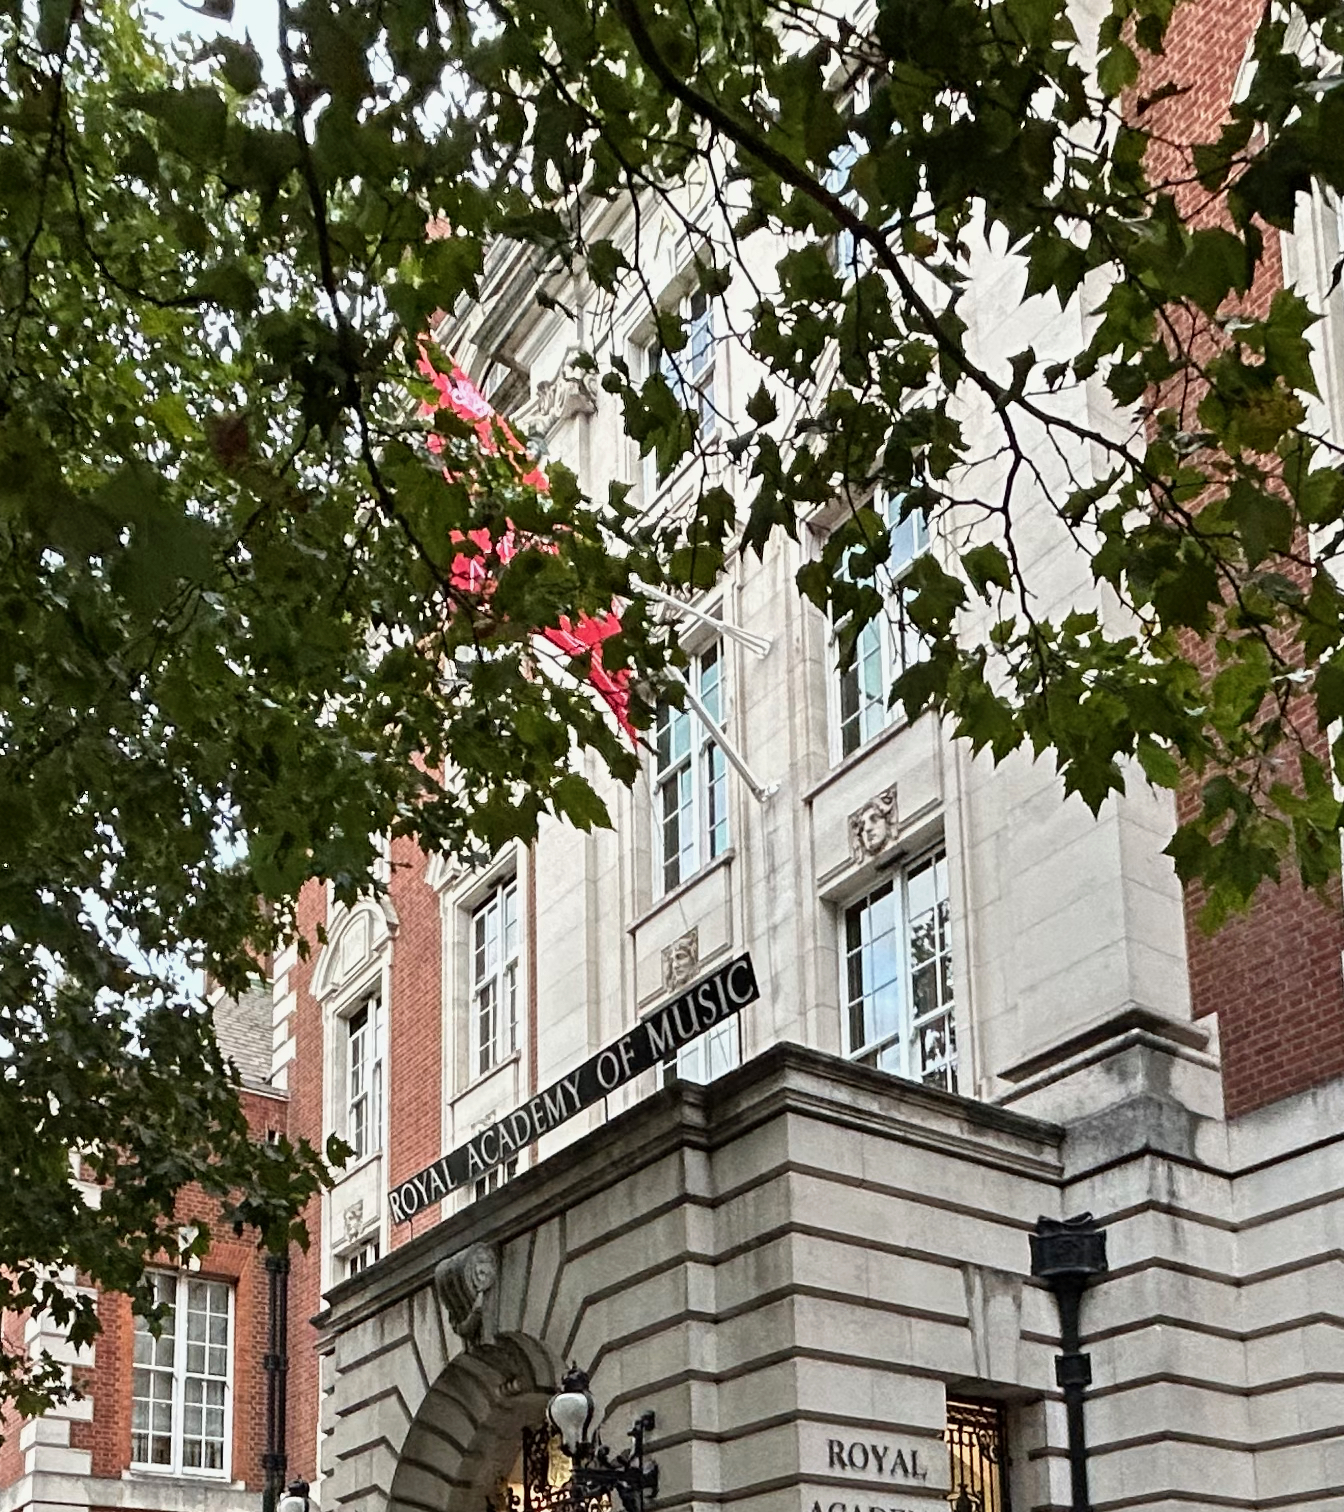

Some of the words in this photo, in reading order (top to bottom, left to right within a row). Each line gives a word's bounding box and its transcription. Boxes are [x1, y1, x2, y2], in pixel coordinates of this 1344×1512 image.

[389, 1160, 457, 1223] ROYAL
[467, 1071, 582, 1177] ACADEMY
[597, 1036, 635, 1089] OF
[645, 960, 753, 1059] MUSIC
[828, 1439, 927, 1482] ROYAL
